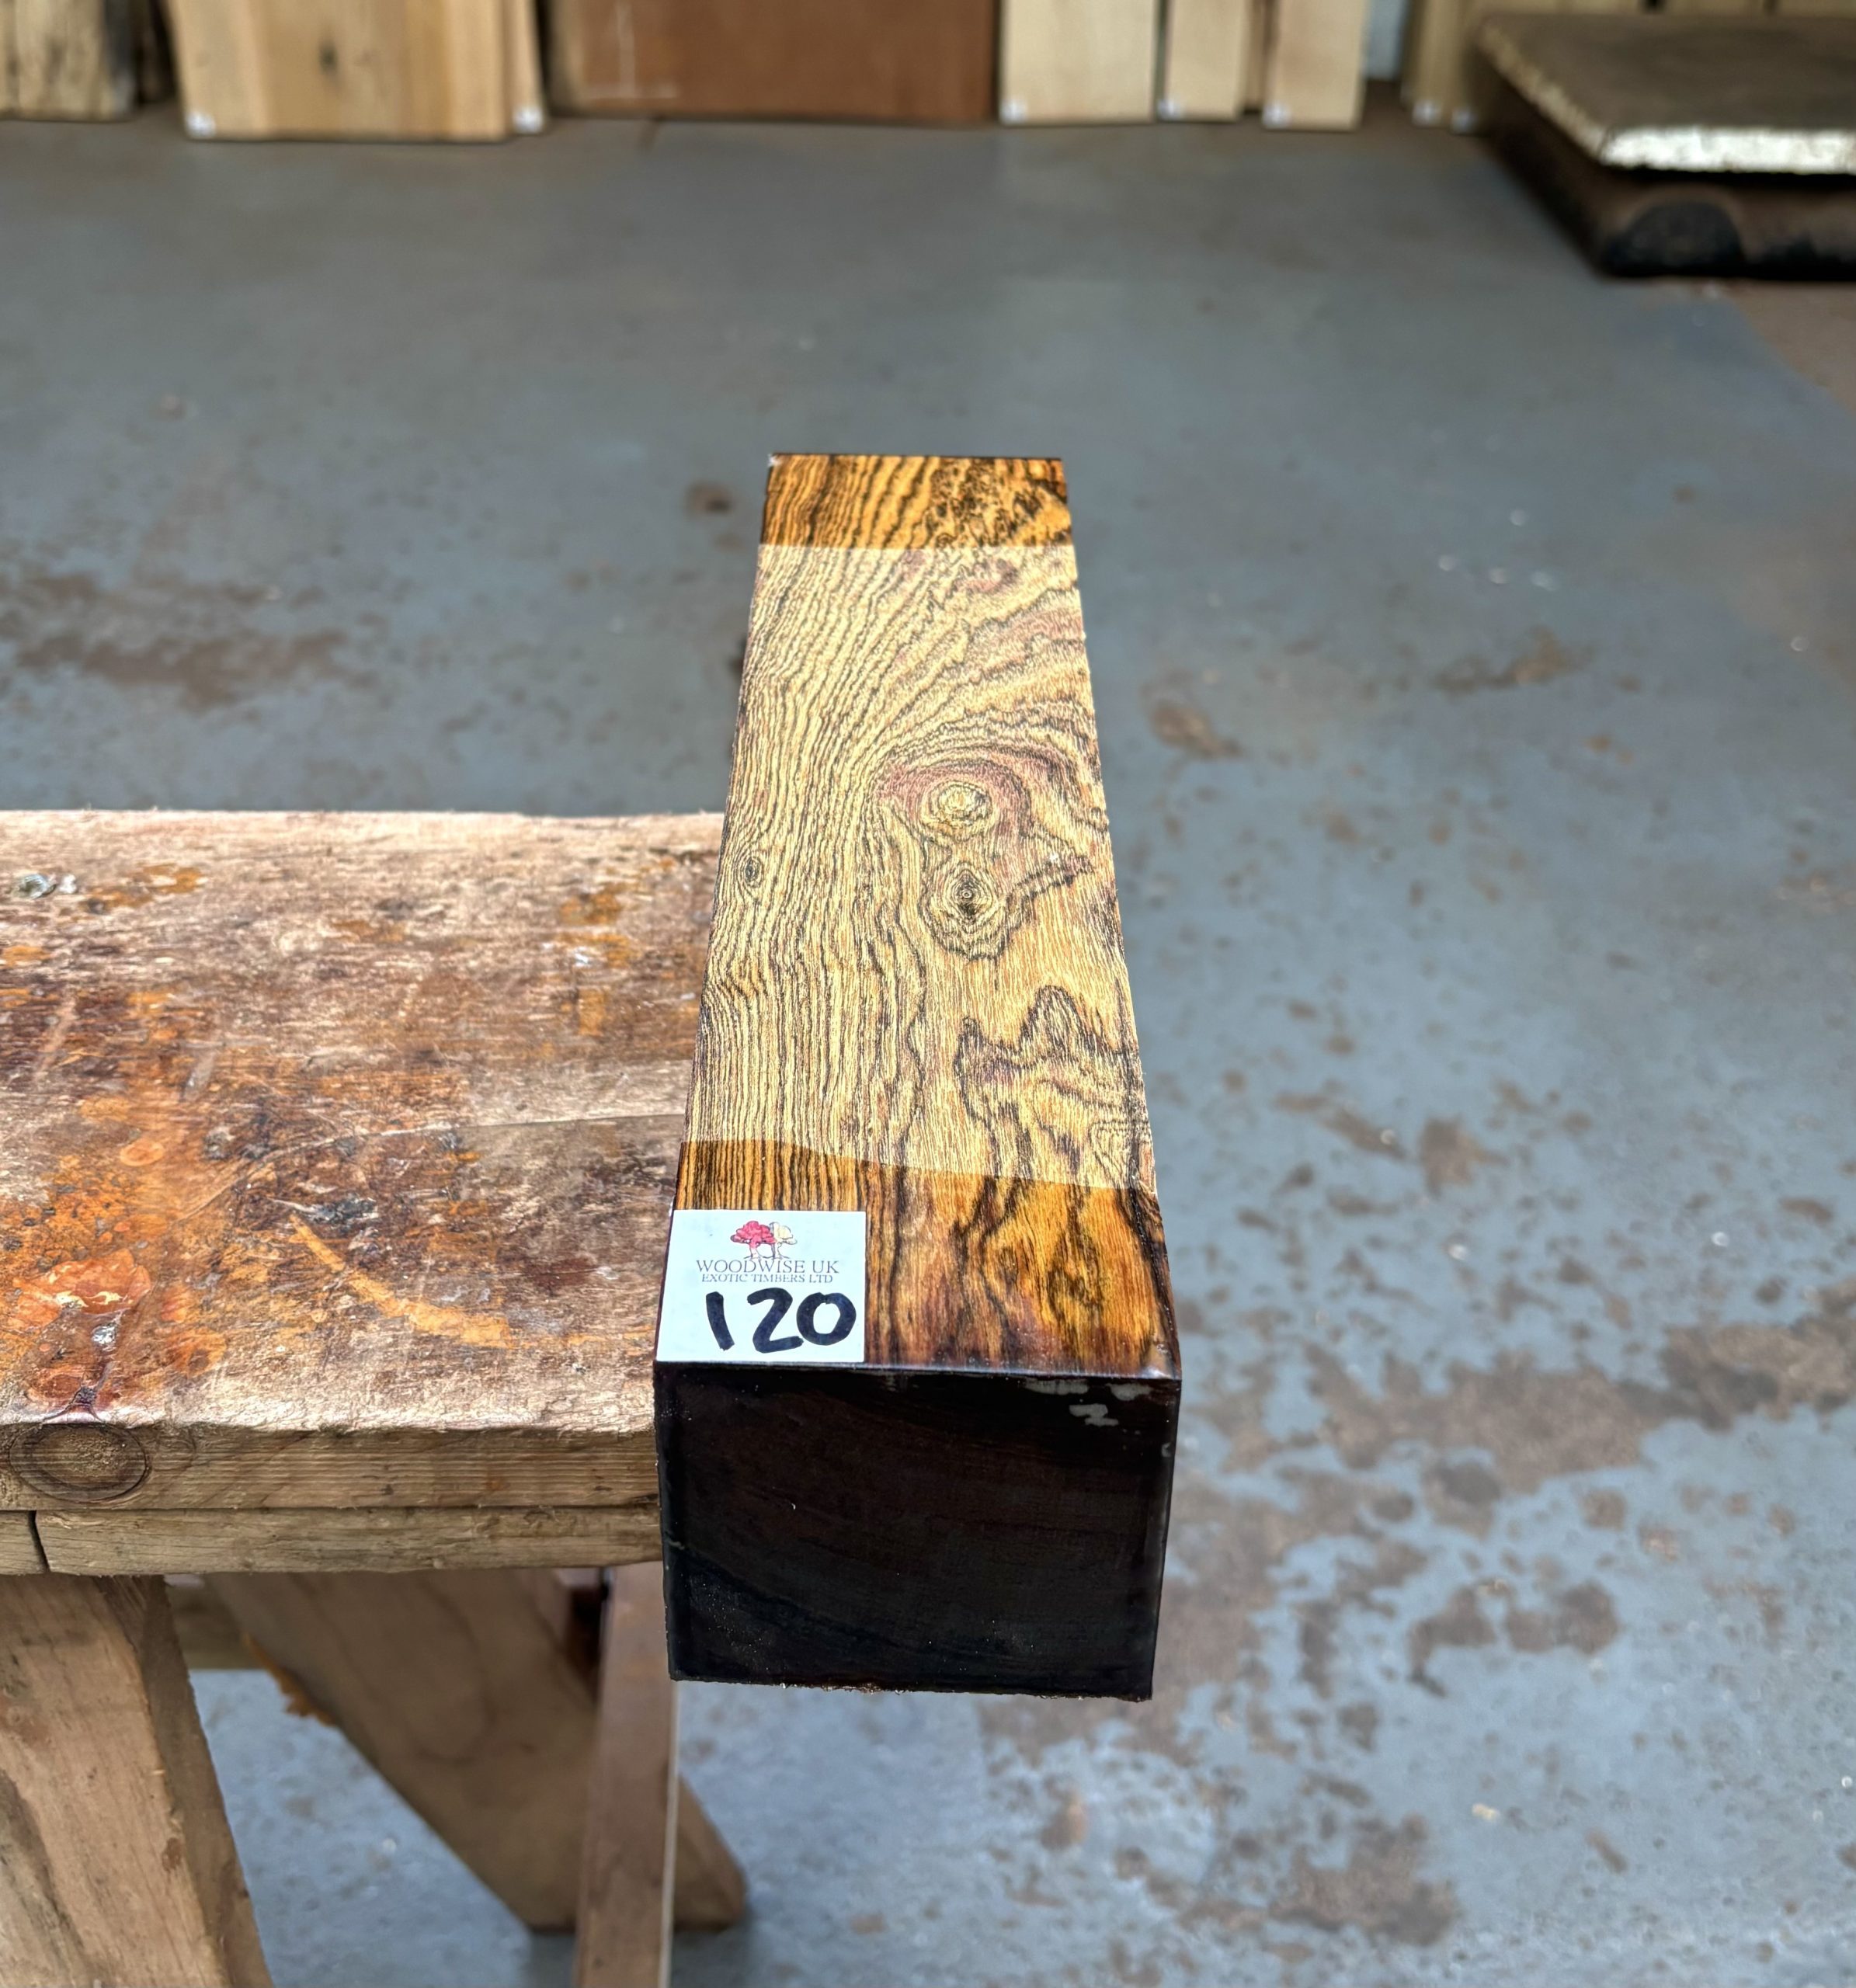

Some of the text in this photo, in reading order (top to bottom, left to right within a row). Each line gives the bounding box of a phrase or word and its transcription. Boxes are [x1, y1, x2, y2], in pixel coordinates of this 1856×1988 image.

[696, 1259, 839, 1274] WOODWISE UK
[701, 1274, 834, 1284] EXOTIC TIMBERS LTD
[705, 1287, 857, 1354] 120
